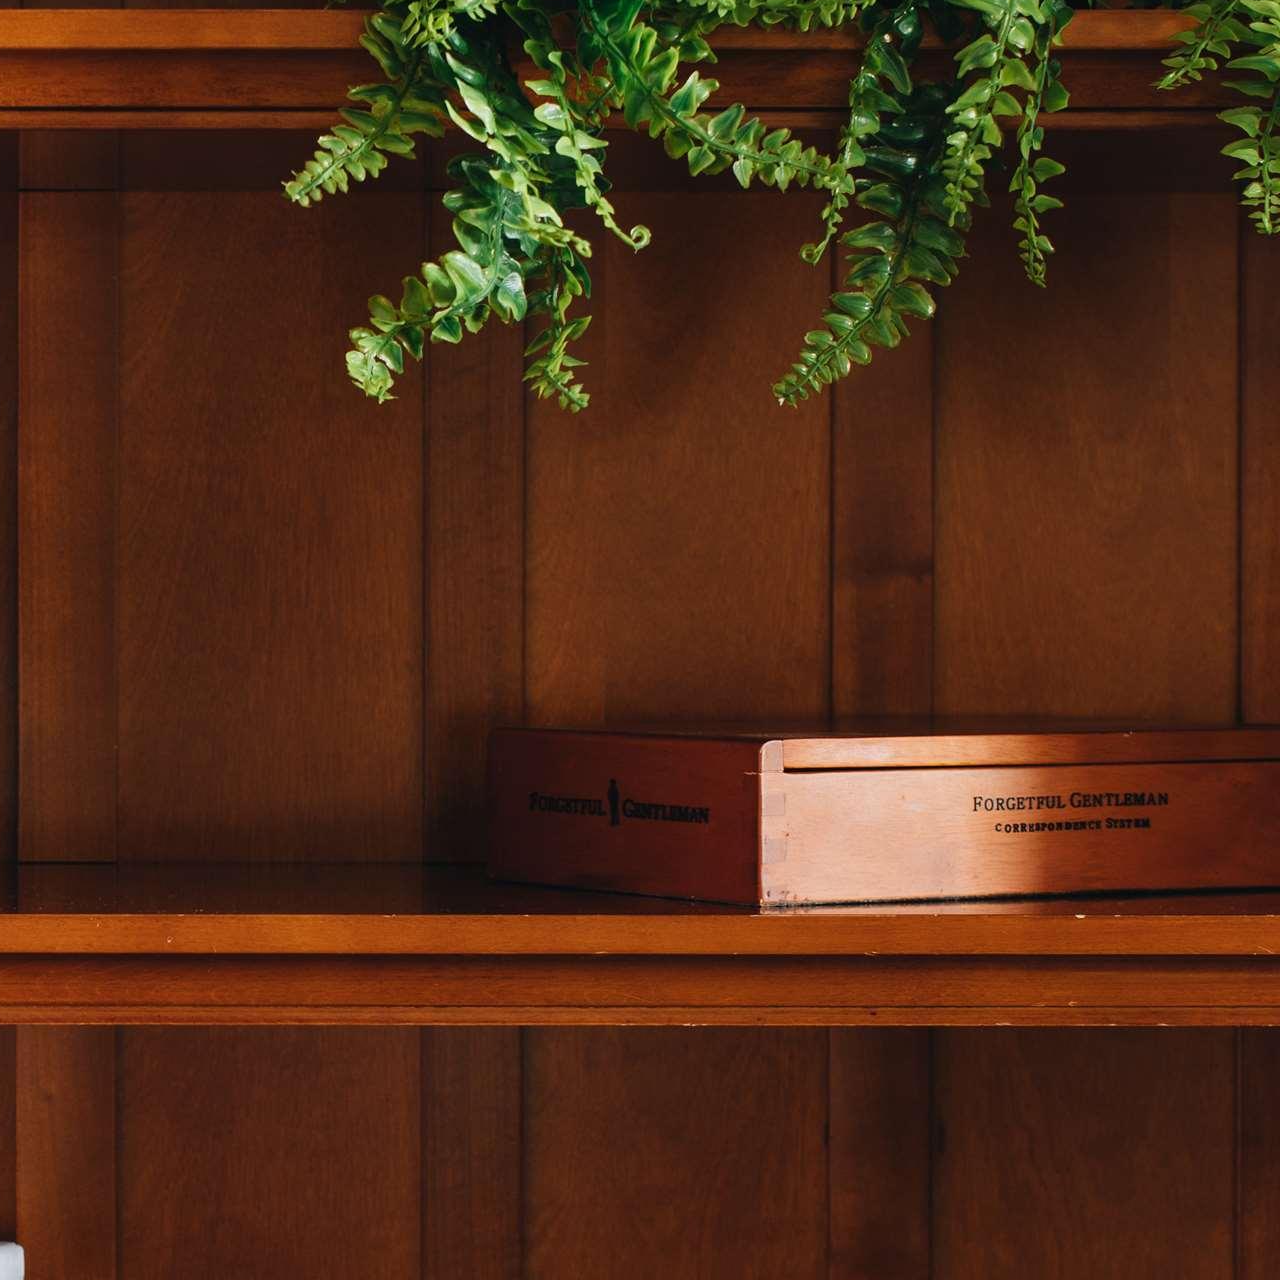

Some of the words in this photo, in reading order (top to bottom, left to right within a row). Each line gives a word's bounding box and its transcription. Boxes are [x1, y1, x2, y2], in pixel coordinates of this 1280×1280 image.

[622, 798, 711, 825] GENTLEMAN
[973, 794, 1067, 812] FORGETFUL
[1069, 791, 1169, 810] GENTLEMAN
